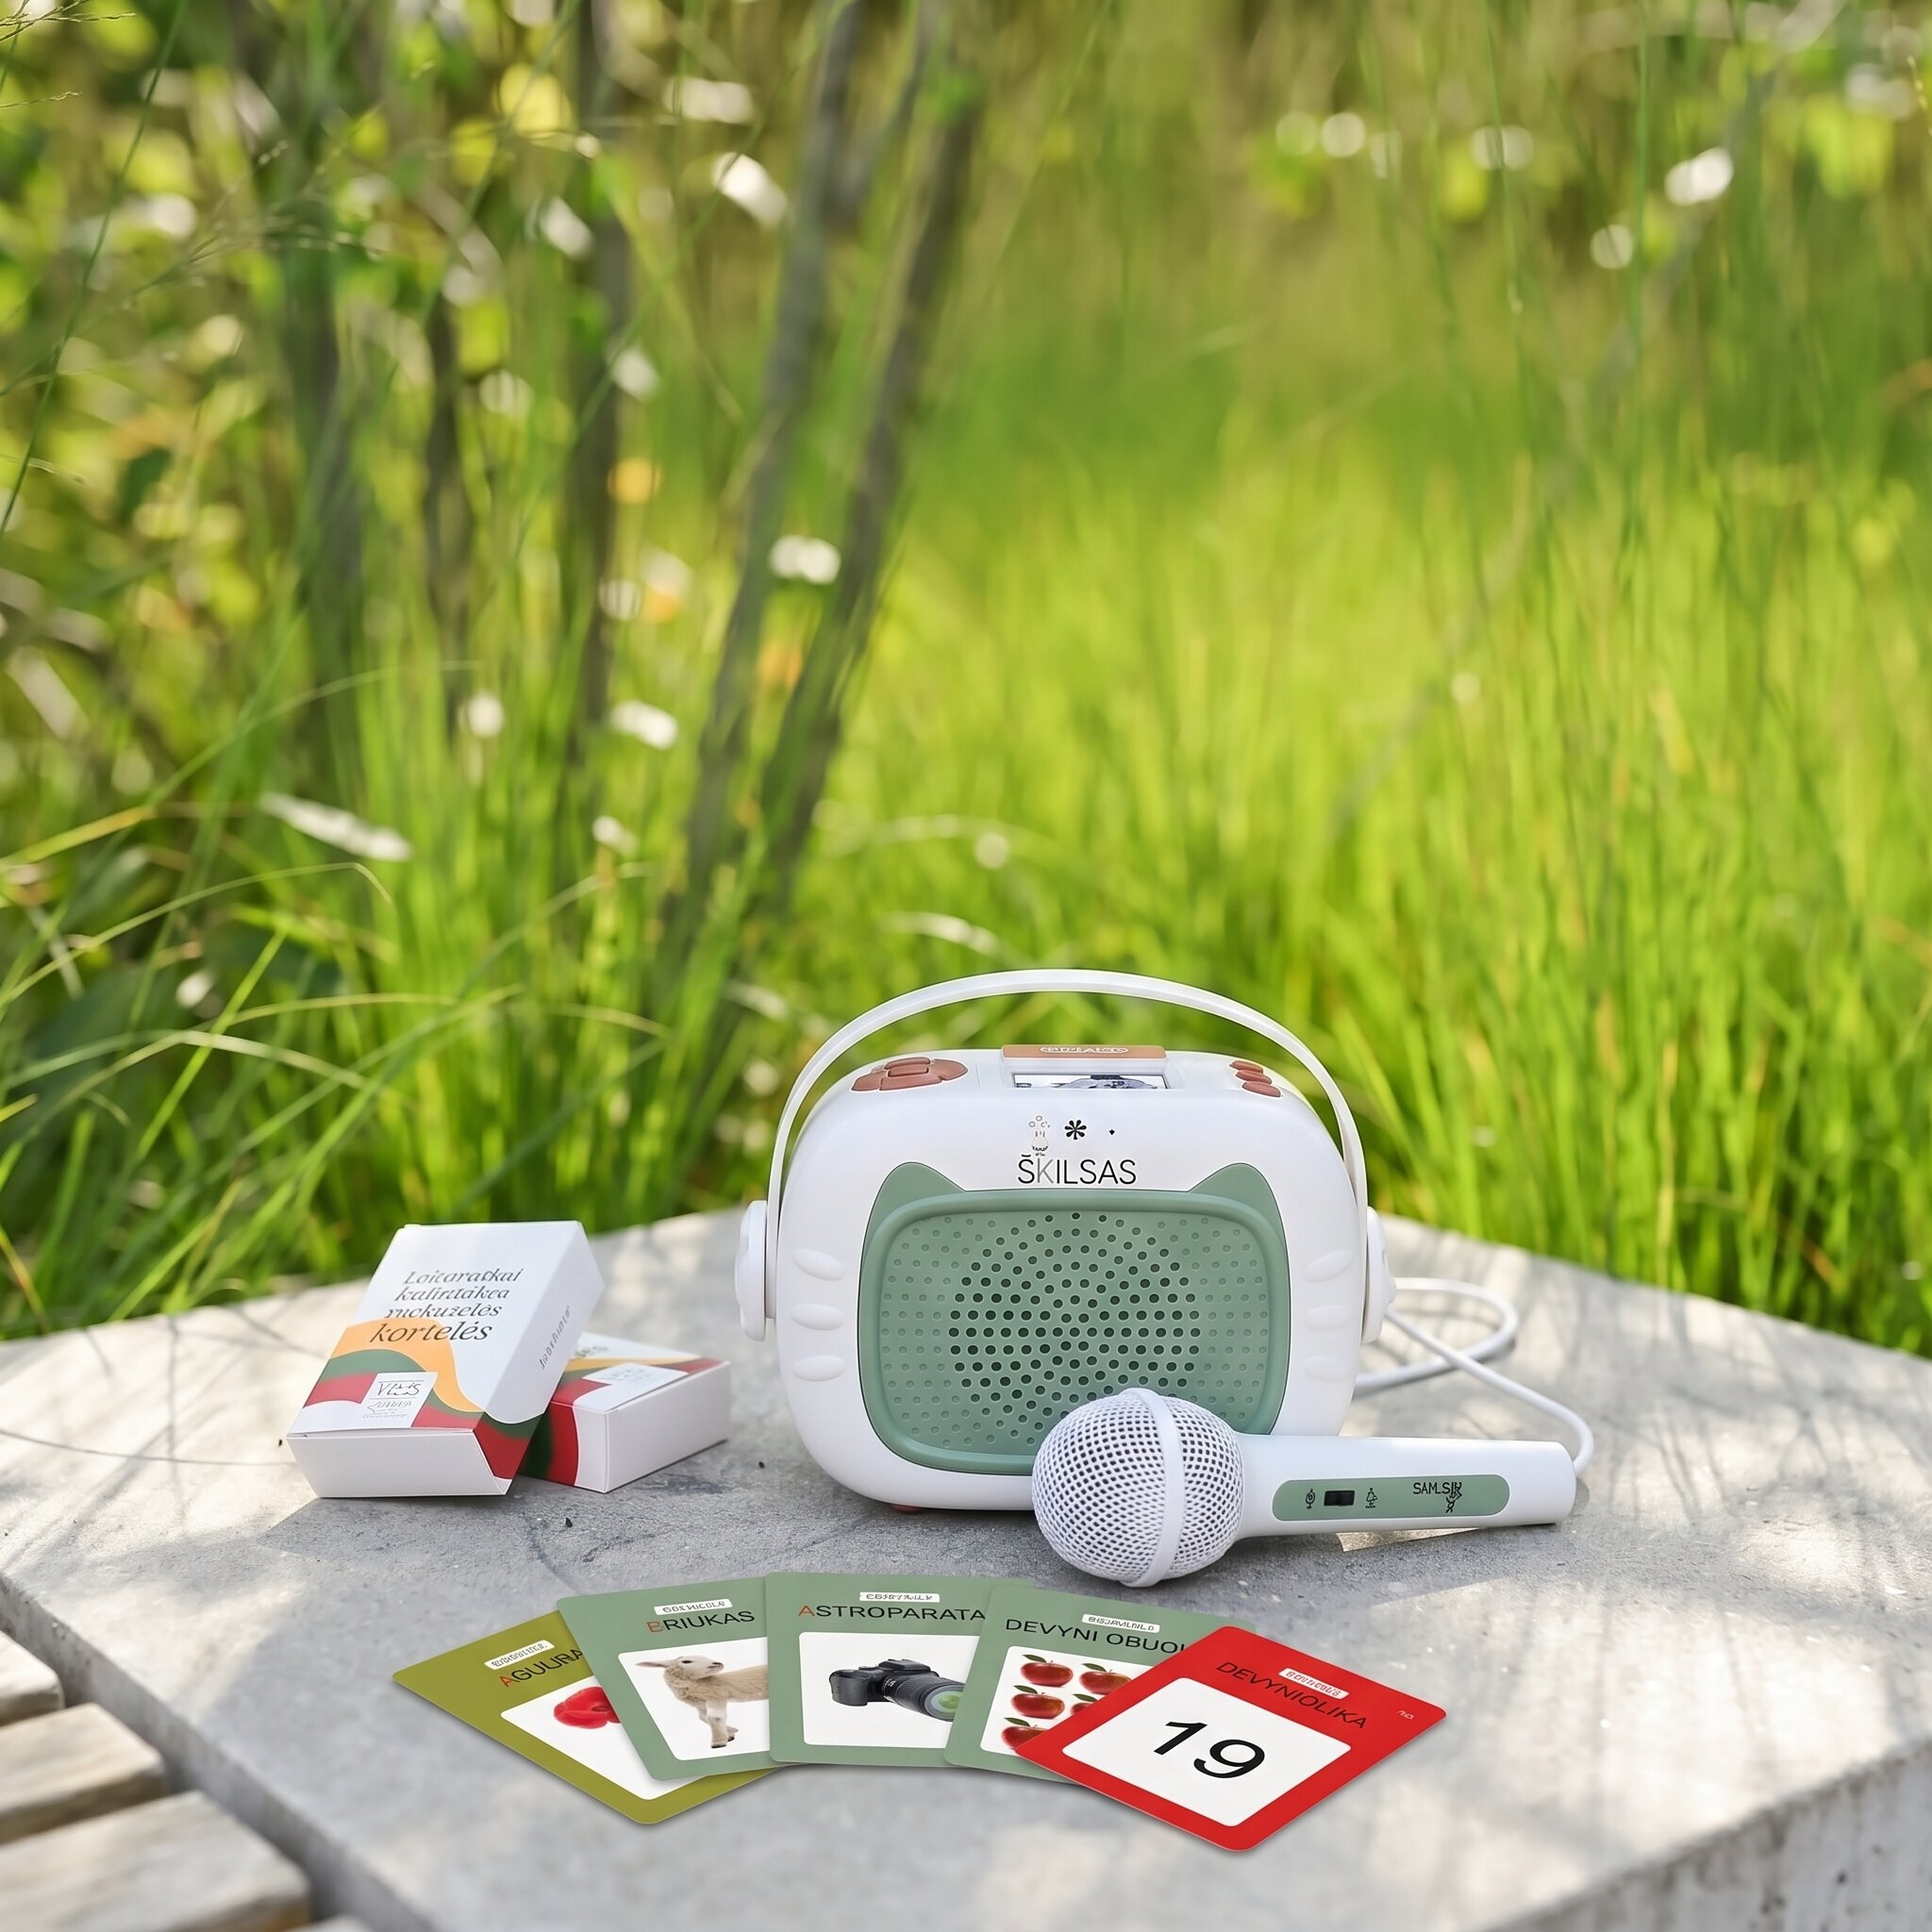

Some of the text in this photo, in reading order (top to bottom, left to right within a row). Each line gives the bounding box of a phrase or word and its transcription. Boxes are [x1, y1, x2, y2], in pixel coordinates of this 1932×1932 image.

[646, 1610, 755, 1633] BRIUKAS
[798, 1605, 986, 1621] ASTROPARATA
[1006, 1619, 1098, 1641] DEVYNI
[1216, 1661, 1367, 1729] DEVYNIOLIKA
[1152, 1721, 1266, 1778] 19
